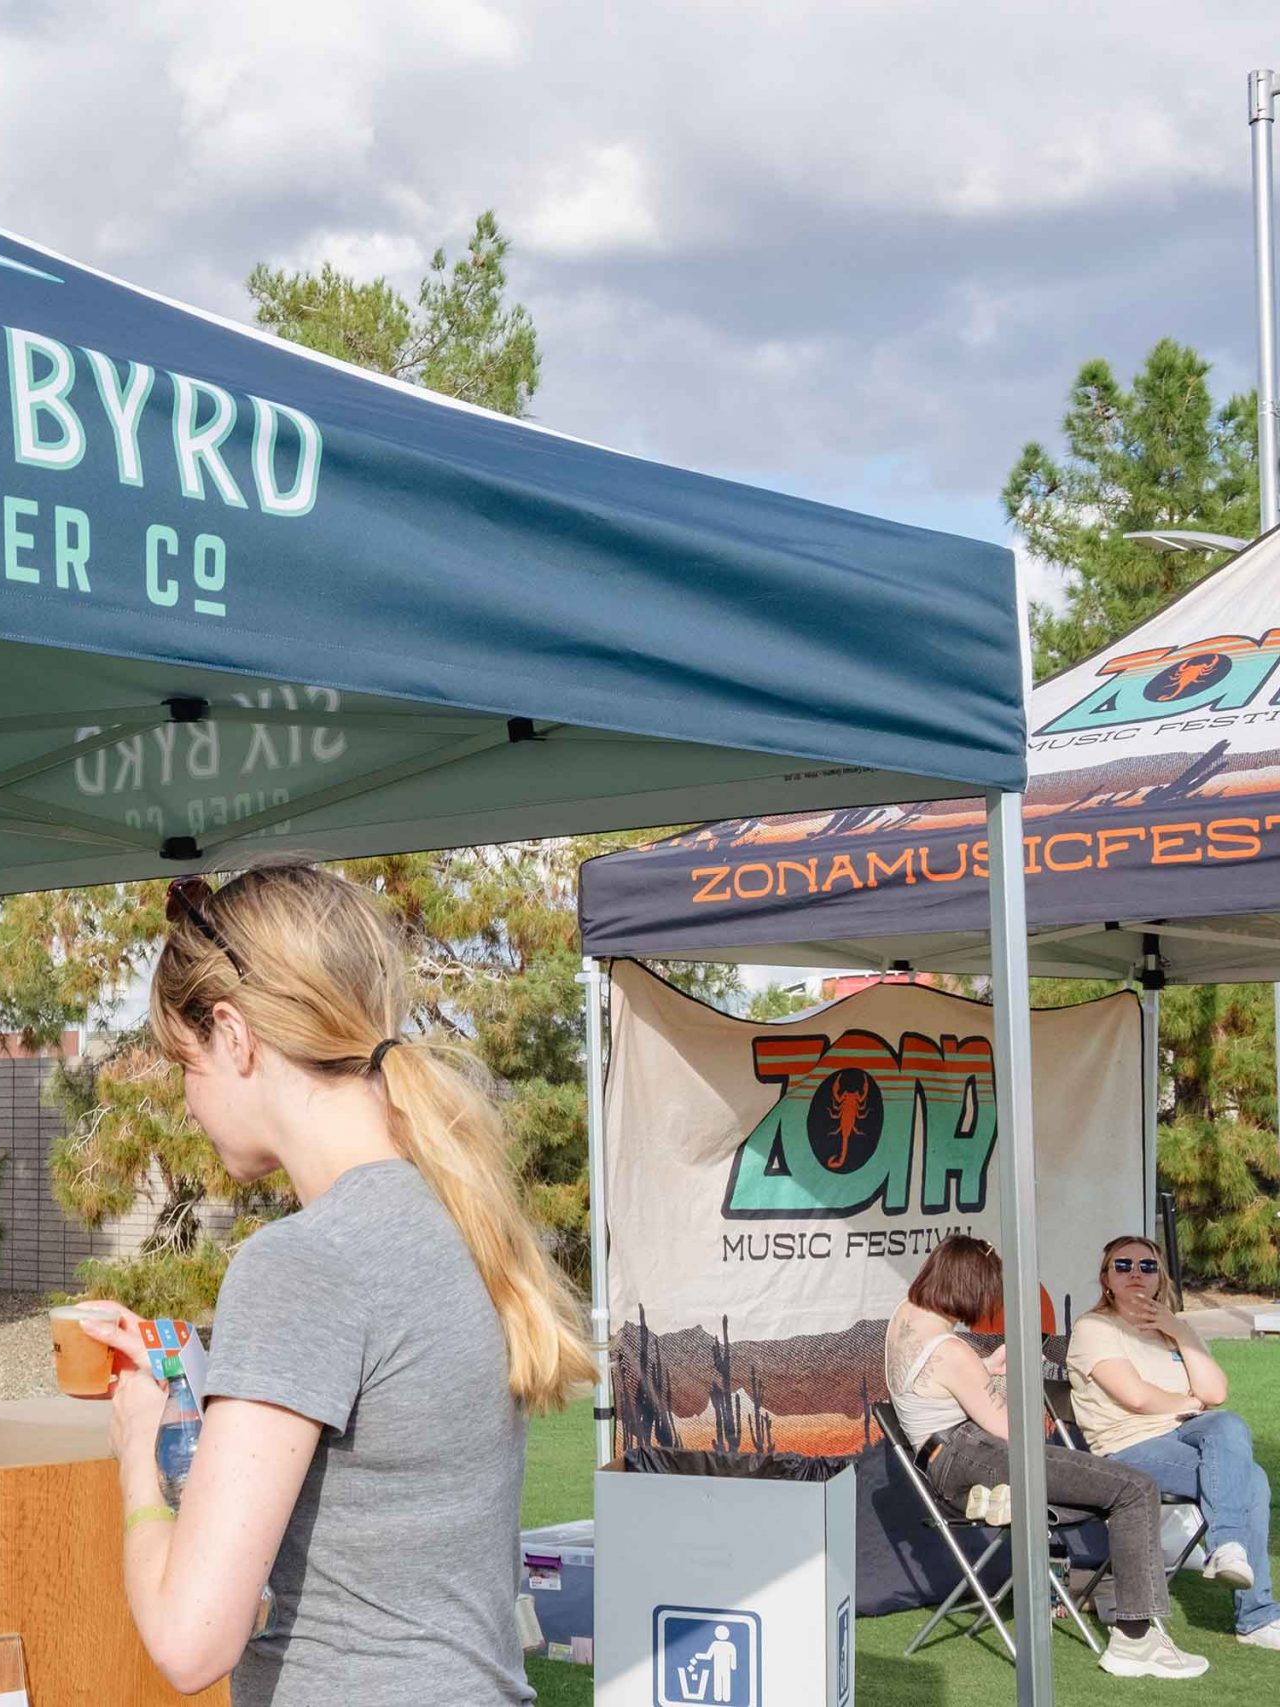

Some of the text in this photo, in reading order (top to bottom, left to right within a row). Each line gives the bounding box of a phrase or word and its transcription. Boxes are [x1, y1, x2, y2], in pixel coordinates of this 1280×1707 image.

[3, 325, 323, 518] BYRD
[1028, 727, 1141, 752] MUSIC
[723, 1226, 972, 1262] MUSIC FESTIV
